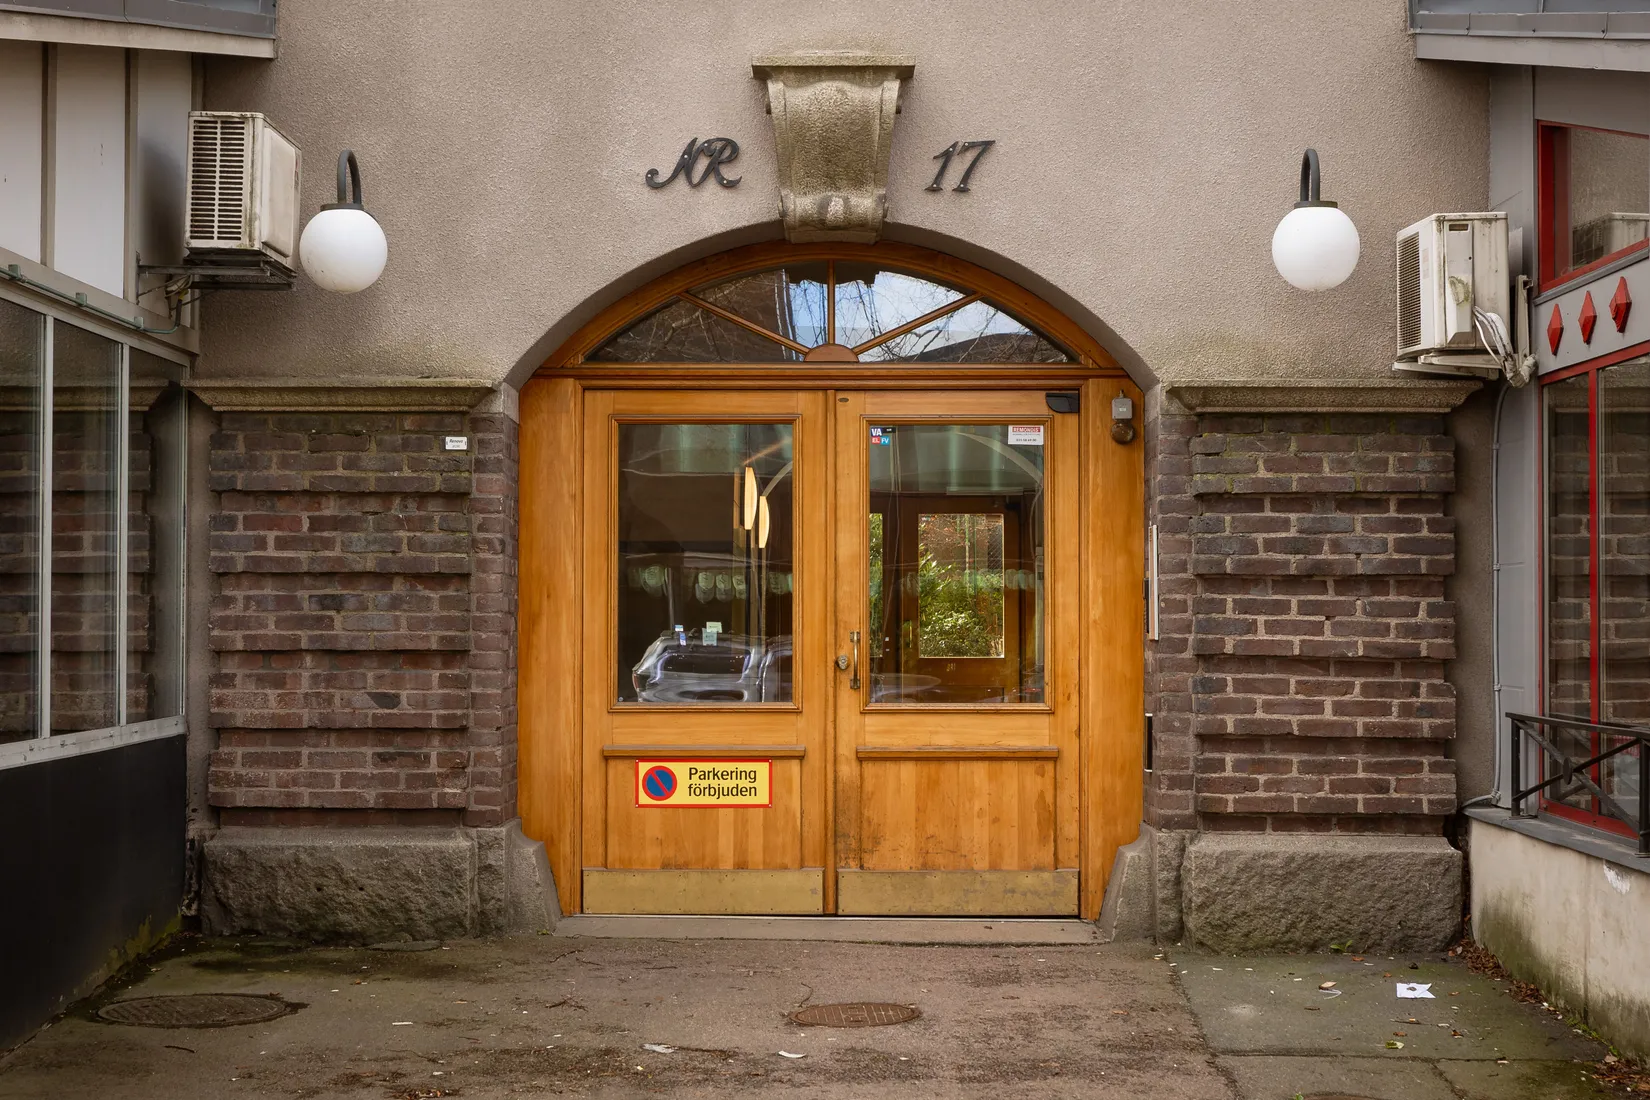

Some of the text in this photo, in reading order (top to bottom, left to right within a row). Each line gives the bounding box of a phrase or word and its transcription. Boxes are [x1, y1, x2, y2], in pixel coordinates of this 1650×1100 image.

[924, 140, 995, 192] 17
[871, 428, 882, 436] VA
[688, 767, 757, 783] Parkering
[688, 783, 757, 799] förbjuden
